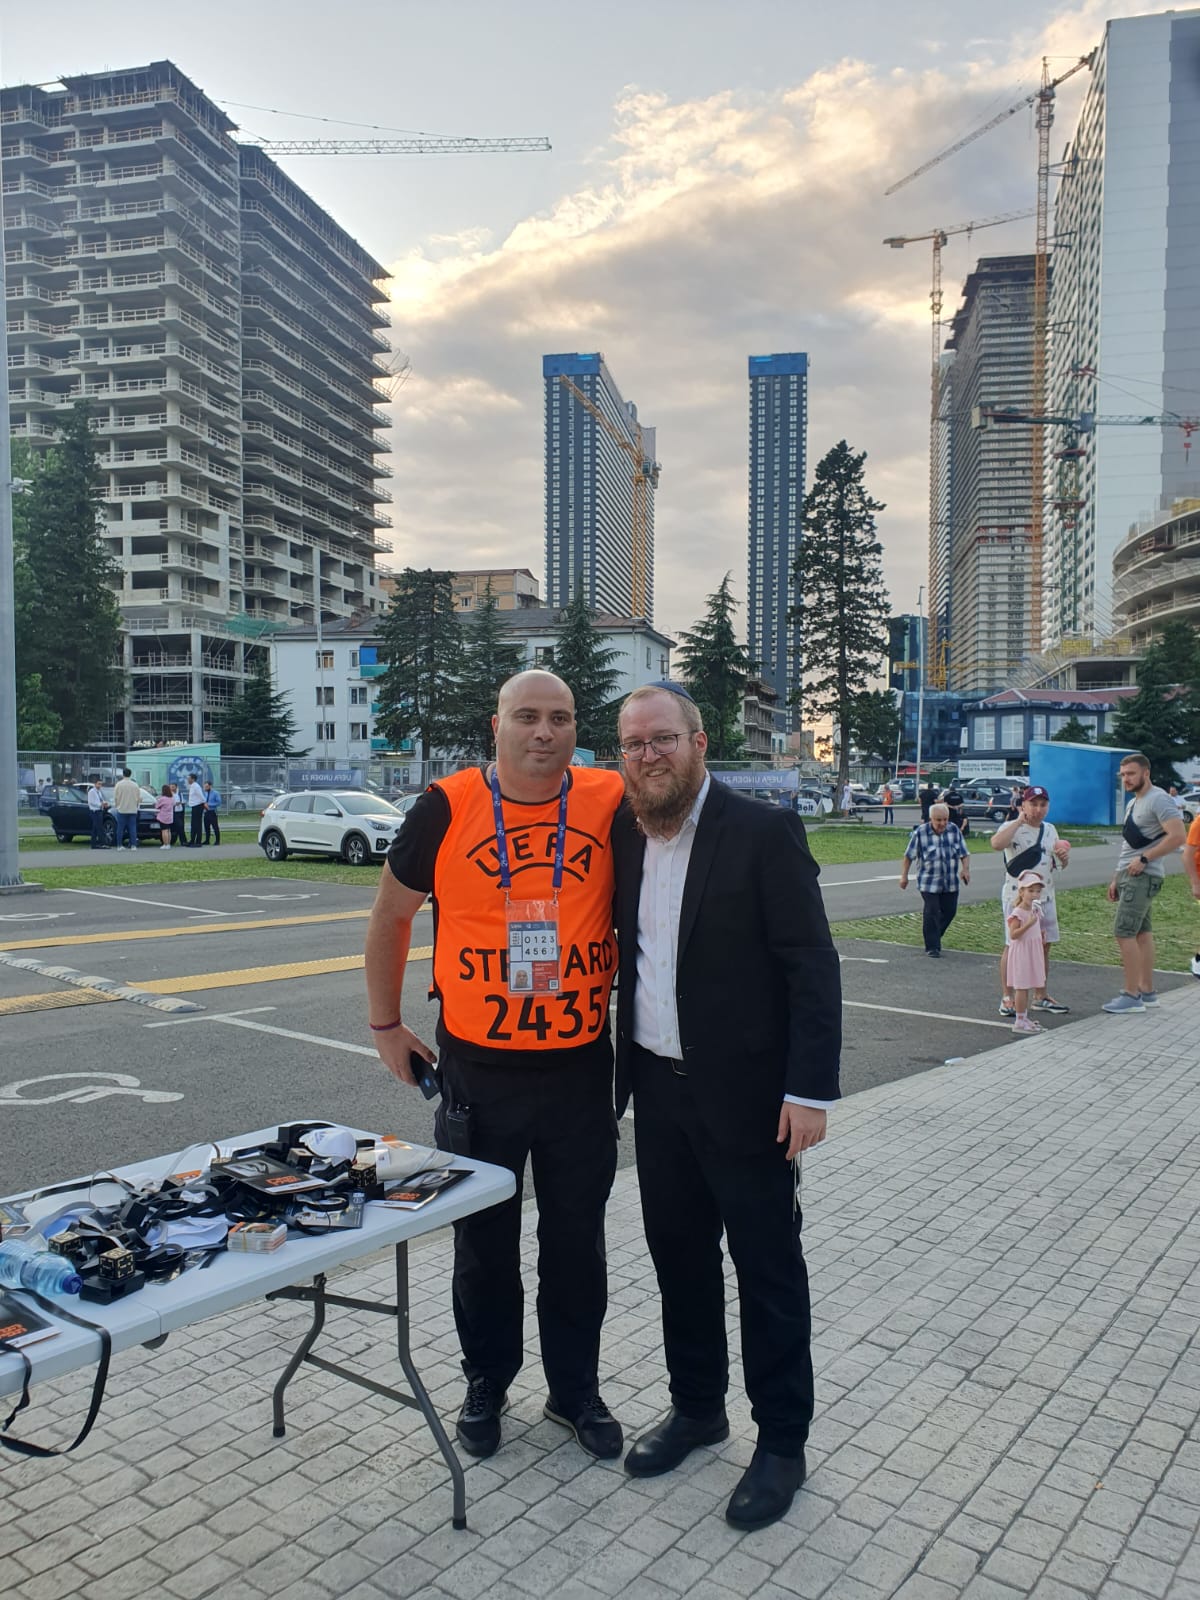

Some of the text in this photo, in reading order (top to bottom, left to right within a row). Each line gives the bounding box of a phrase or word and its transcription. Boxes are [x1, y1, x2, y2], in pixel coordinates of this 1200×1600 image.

[475, 832, 593, 877] UEFA
[459, 942, 613, 982] STARD
[484, 986, 603, 1041] 2435
